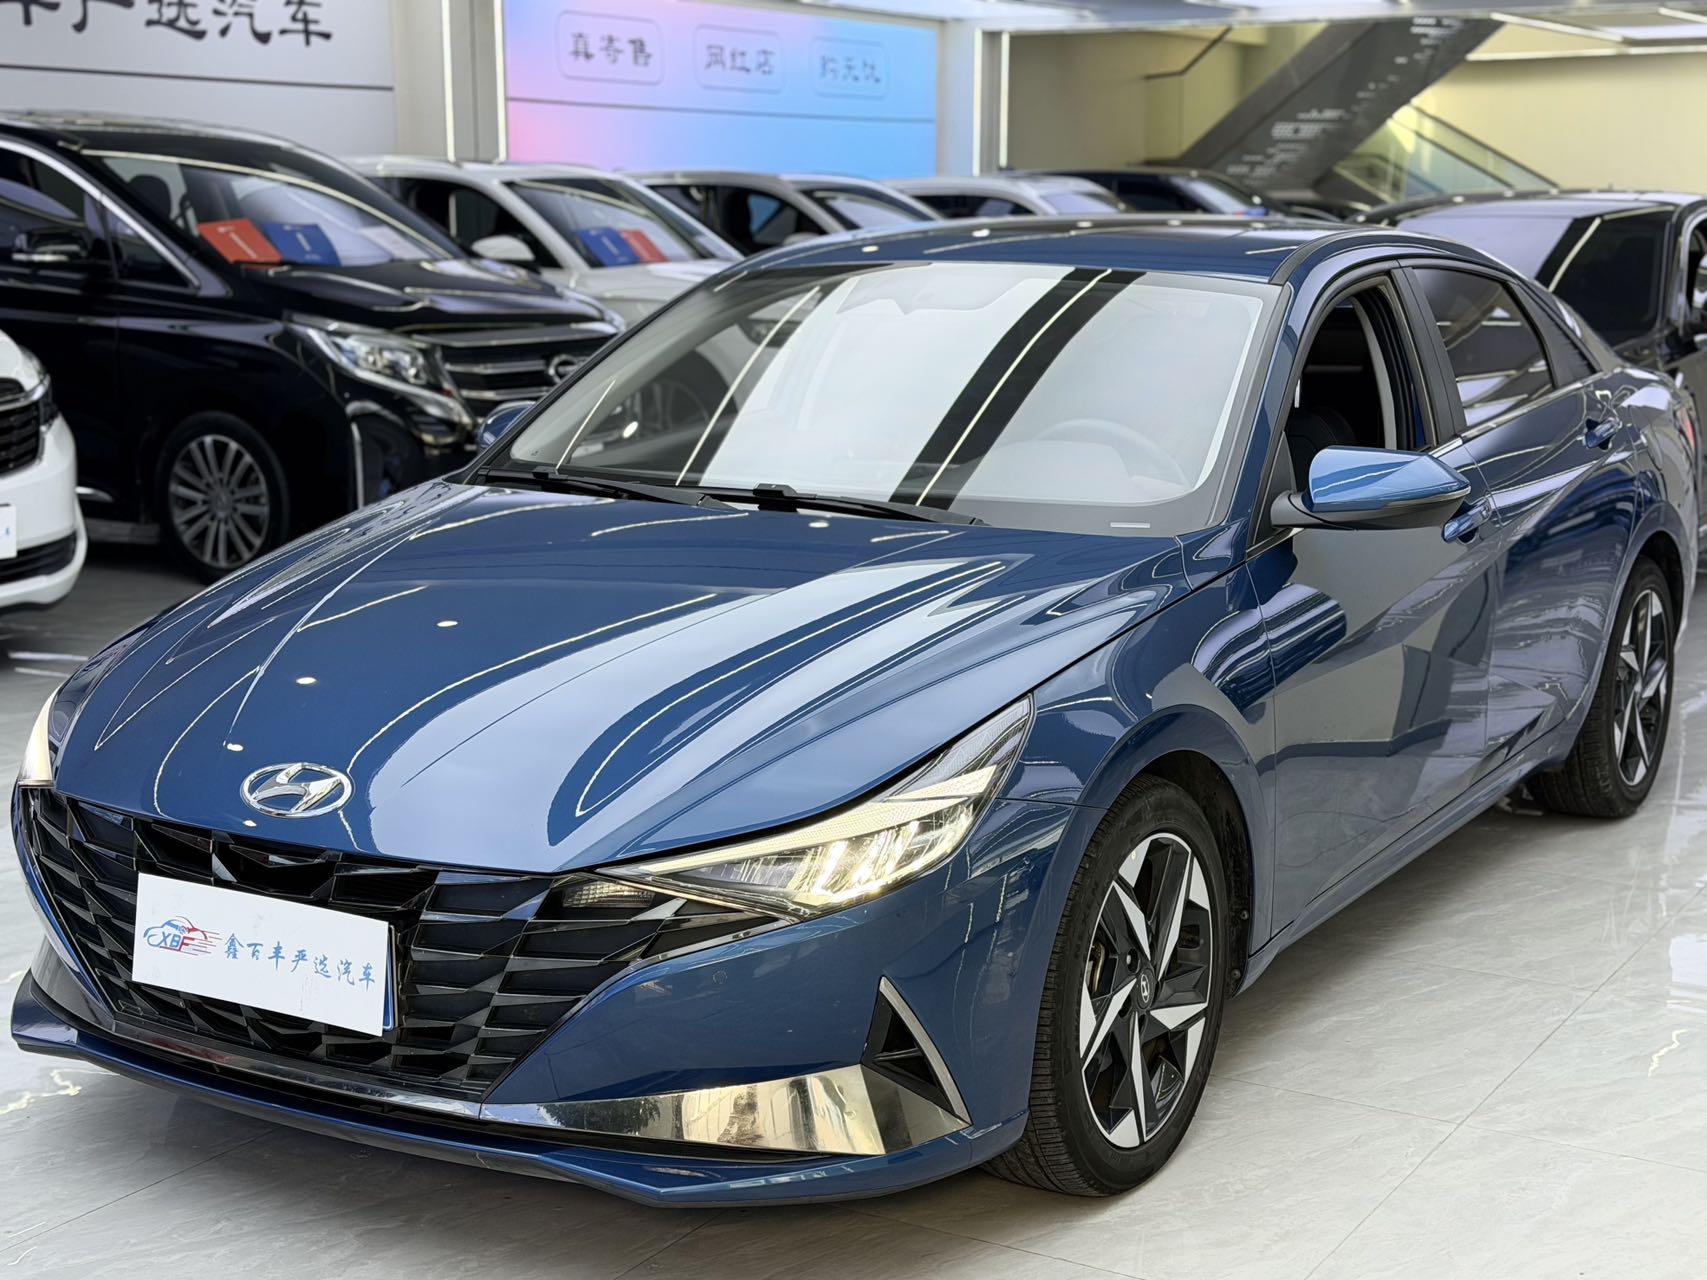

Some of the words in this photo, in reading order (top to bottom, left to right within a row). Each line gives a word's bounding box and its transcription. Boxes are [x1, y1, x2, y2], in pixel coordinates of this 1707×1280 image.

[224, 932, 376, 991] 鑫百丰严选汽车
